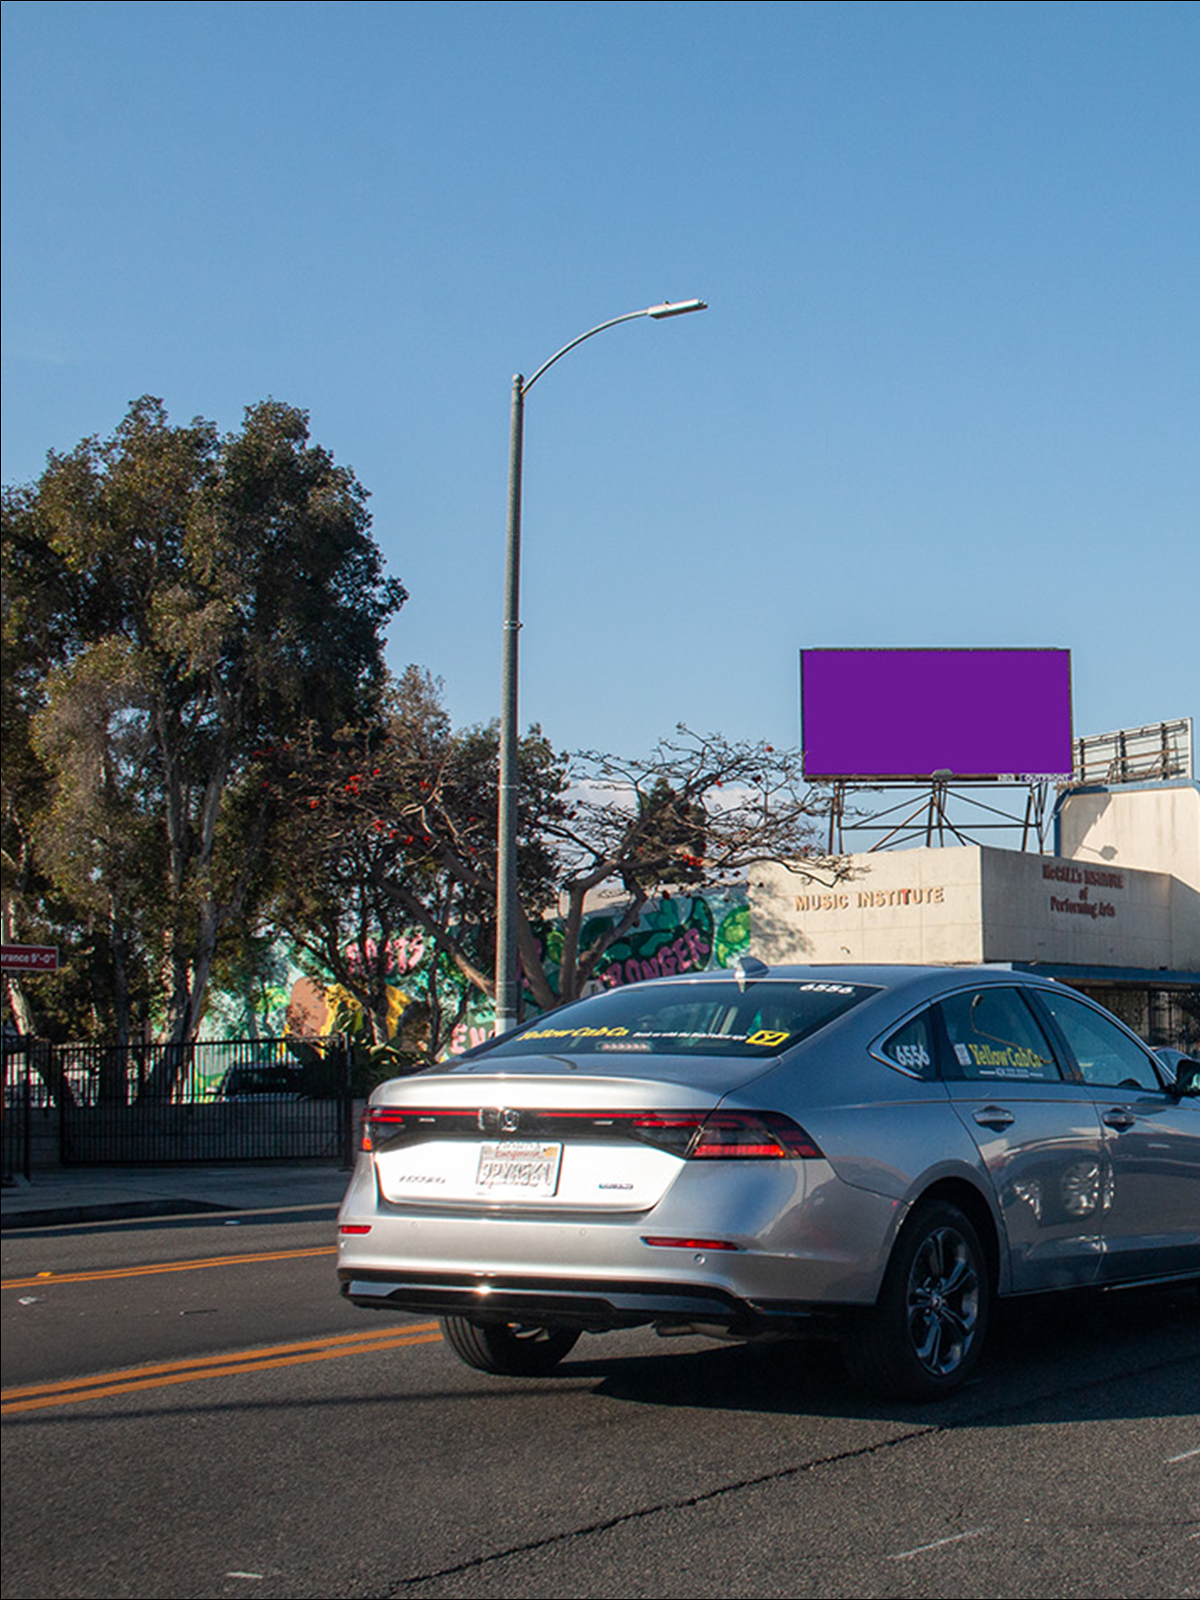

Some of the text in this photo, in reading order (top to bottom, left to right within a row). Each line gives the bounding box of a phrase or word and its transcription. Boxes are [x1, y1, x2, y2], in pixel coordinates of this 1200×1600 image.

[795, 887, 945, 911] MUSIC INSTITUTE
[1079, 886, 1089, 901] of
[1050, 896, 1097, 919] Performing
[799, 983, 855, 995] 6556
[895, 1044, 931, 1068] 6556
